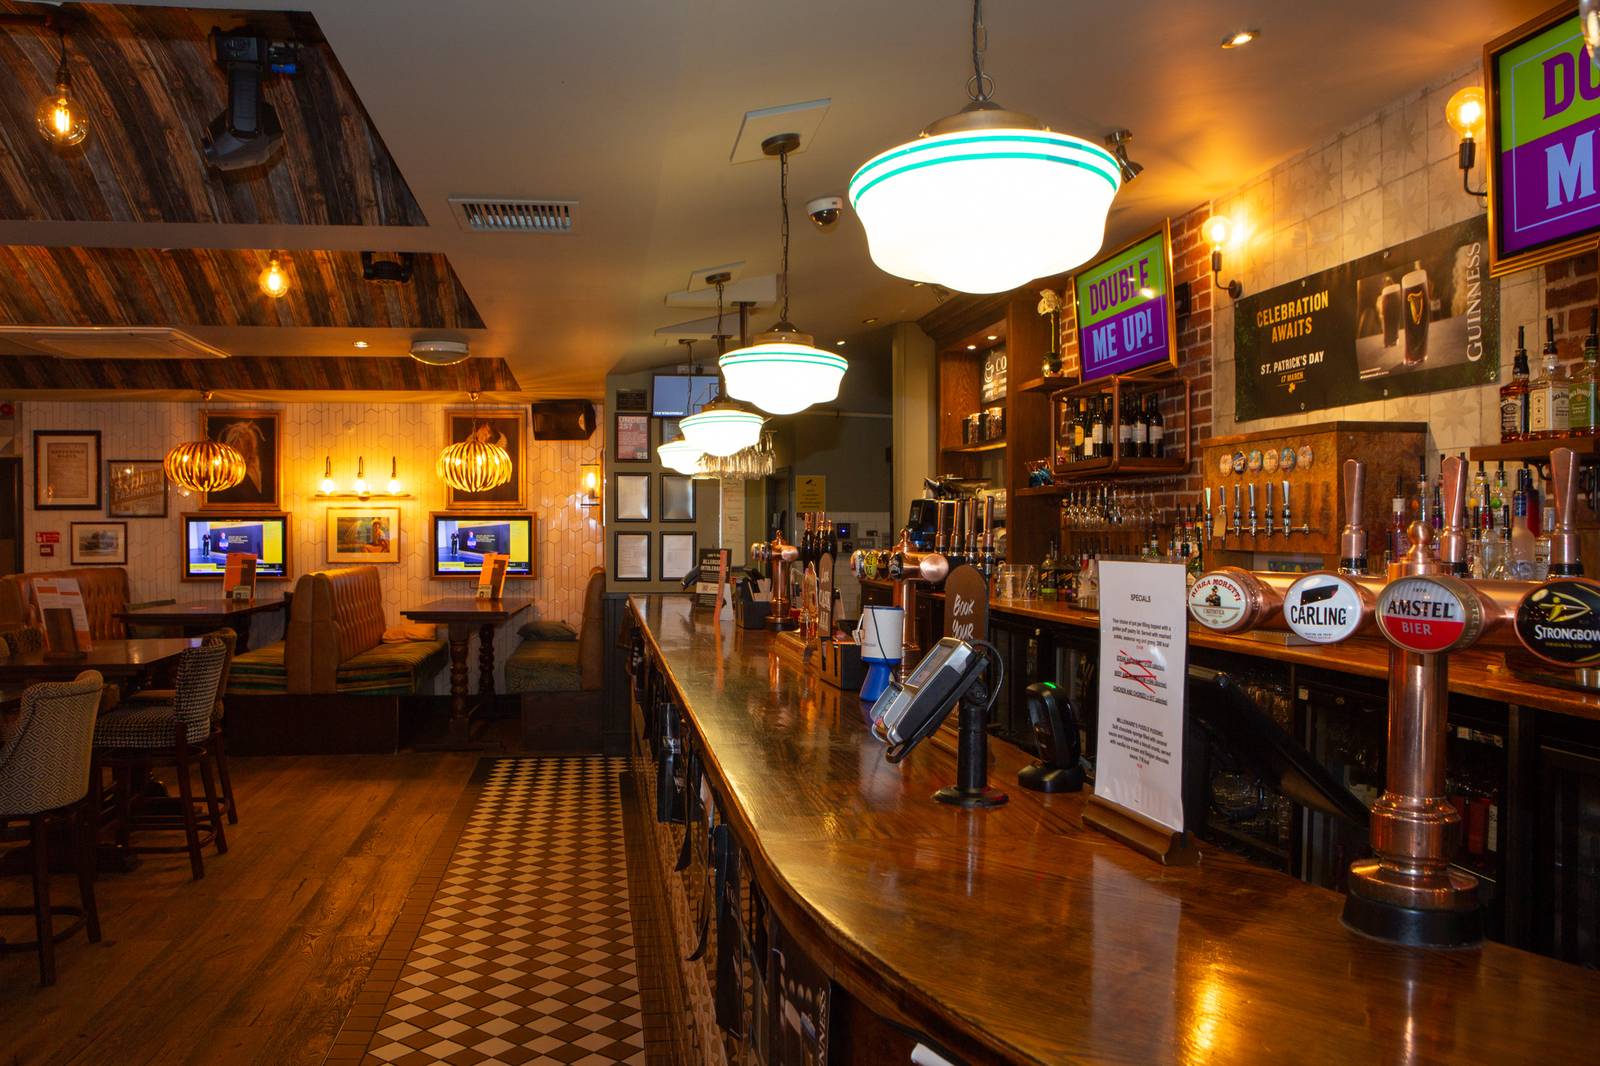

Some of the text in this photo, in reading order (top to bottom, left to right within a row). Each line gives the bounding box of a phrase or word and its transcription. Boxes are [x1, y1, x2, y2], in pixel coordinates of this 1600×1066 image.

[1544, 127, 1600, 210] M
[1089, 257, 1150, 316] DOUBLE
[1256, 290, 1329, 328] CELEBRATION
[1466, 242, 1483, 362] GUINNESS
[1092, 308, 1153, 363] ME UP!
[1271, 317, 1312, 344] AWAITS
[1260, 350, 1324, 375] ST. PATRICK'S DAY
[1287, 370, 1304, 382] MARCH
[1130, 594, 1152, 602] SPECIALS
[1192, 578, 1241, 602] BIRRA MORETTI
[1290, 605, 1347, 626] CARLING
[1388, 600, 1453, 618] AMSTEL
[1402, 622, 1432, 636] BIER
